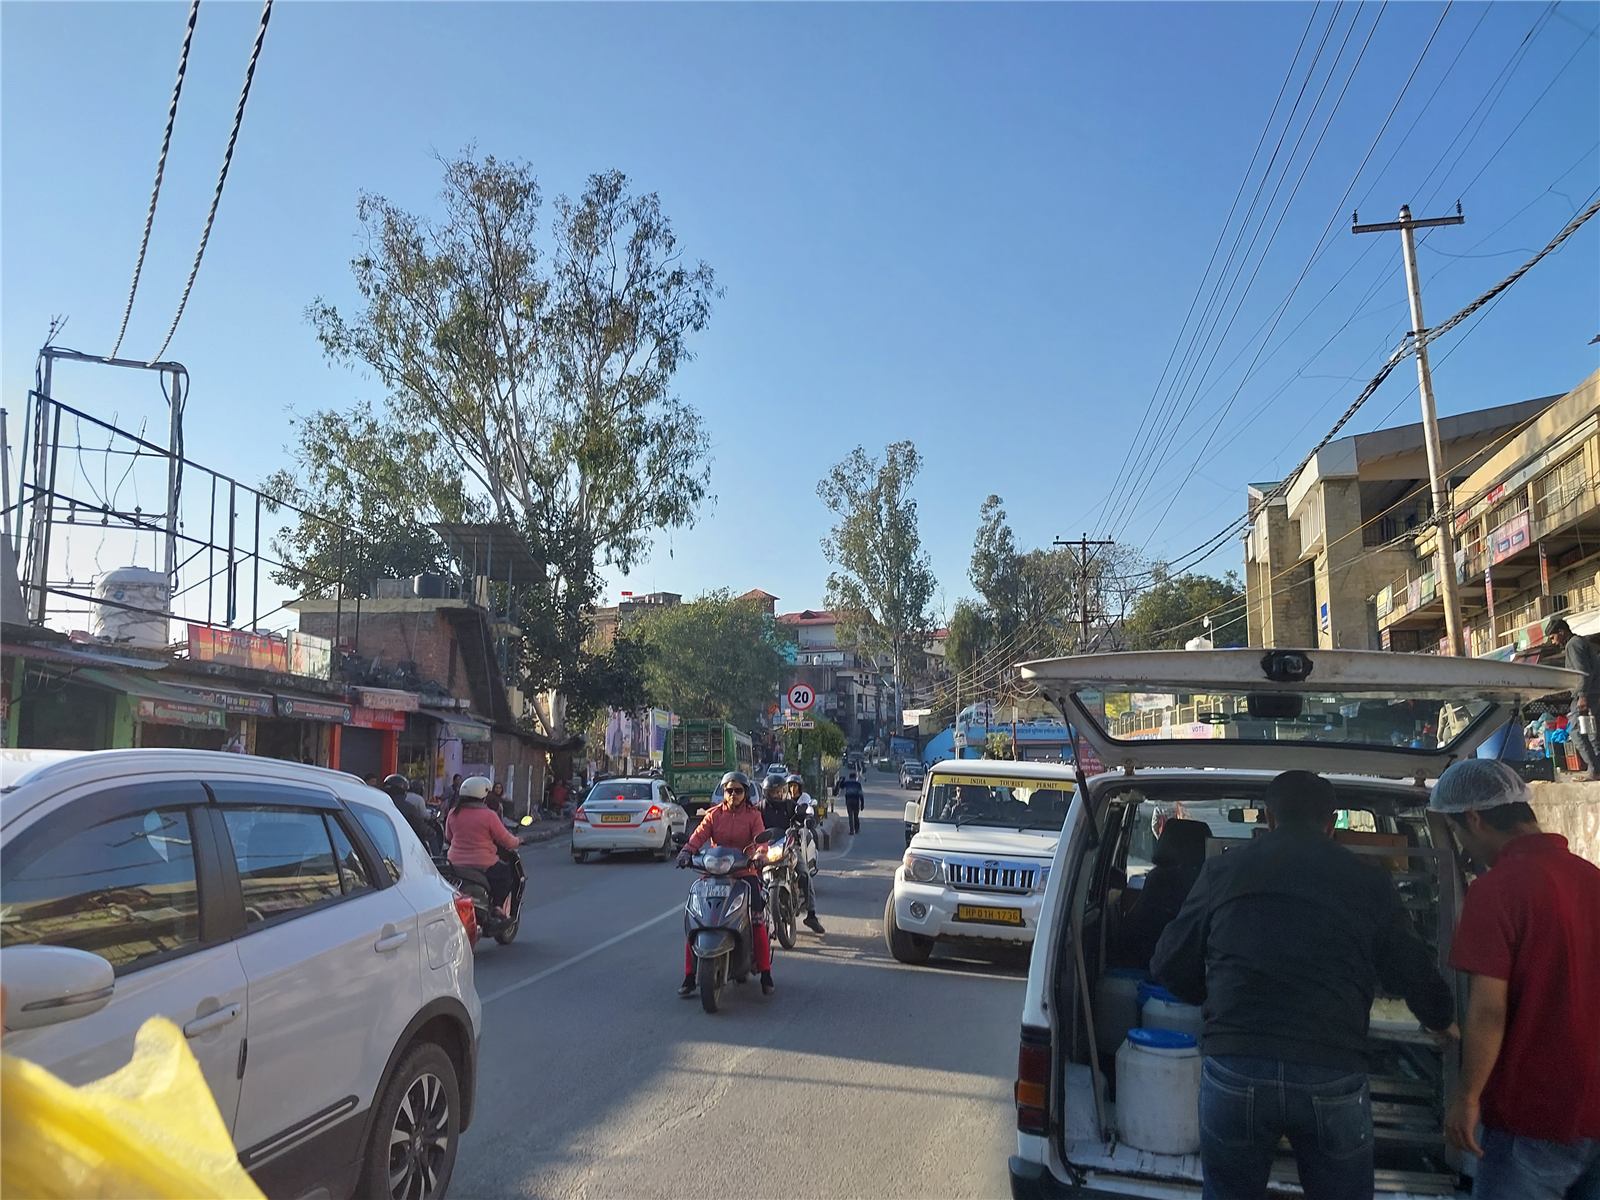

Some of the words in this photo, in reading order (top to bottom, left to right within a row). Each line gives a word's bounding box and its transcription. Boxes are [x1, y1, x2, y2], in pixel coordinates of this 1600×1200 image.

[794, 691, 809, 703] 20
[1191, 724, 1205, 733] VOTE
[1000, 780, 1024, 788] TOURIST
[1036, 781, 1058, 789] PERMIT
